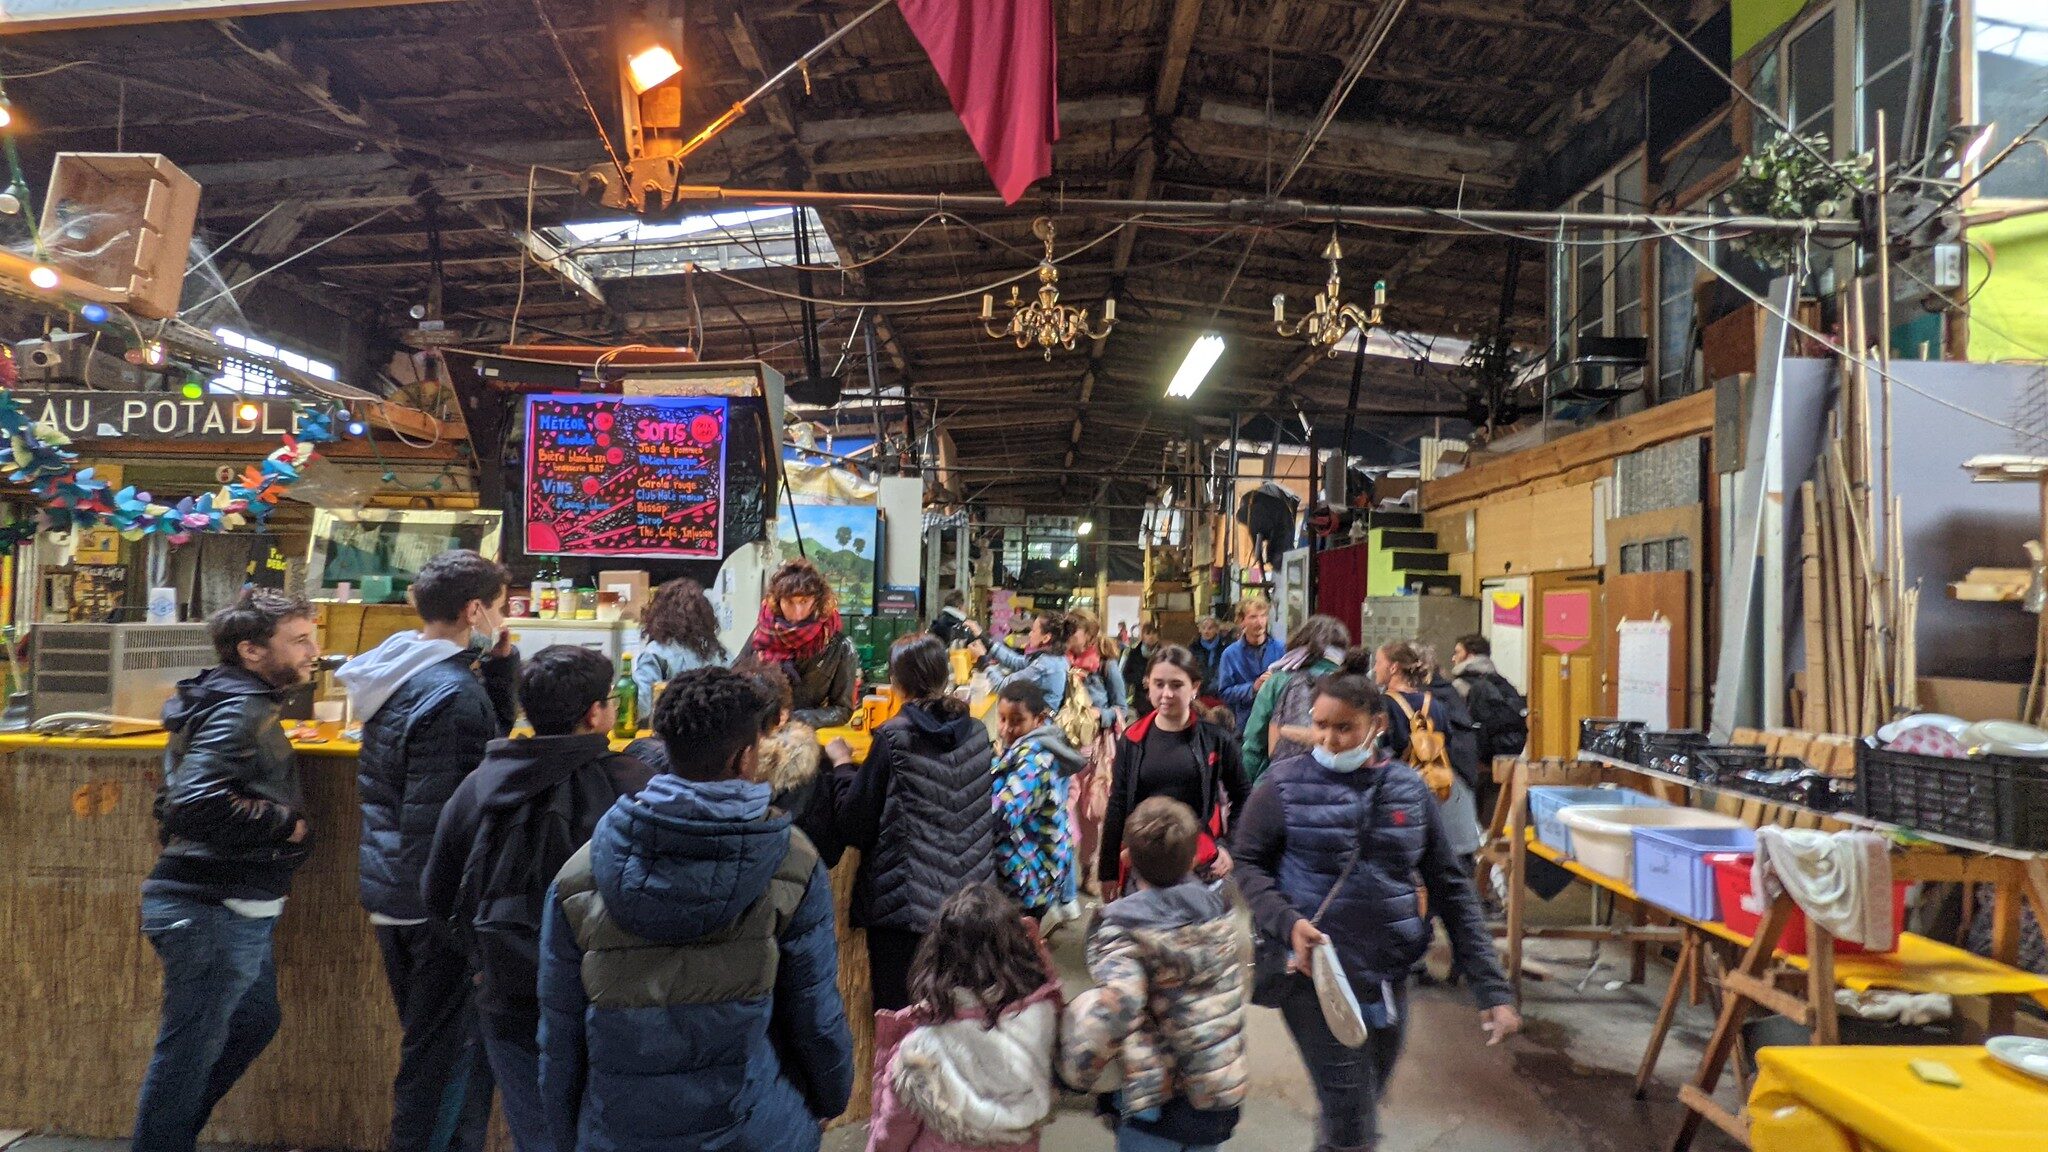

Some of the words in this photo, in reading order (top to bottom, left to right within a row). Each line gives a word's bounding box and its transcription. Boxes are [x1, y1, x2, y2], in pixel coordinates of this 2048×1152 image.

[539, 414, 587, 431] MÉTÉOR
[636, 419, 687, 442] SOFTS
[538, 448, 565, 462] Bière
[659, 442, 671, 453] de
[637, 477, 670, 490] Carola
[673, 479, 698, 493] rouge
[636, 488, 657, 500] Club
[636, 501, 668, 518] Bissap
[636, 513, 664, 527] Sirop
